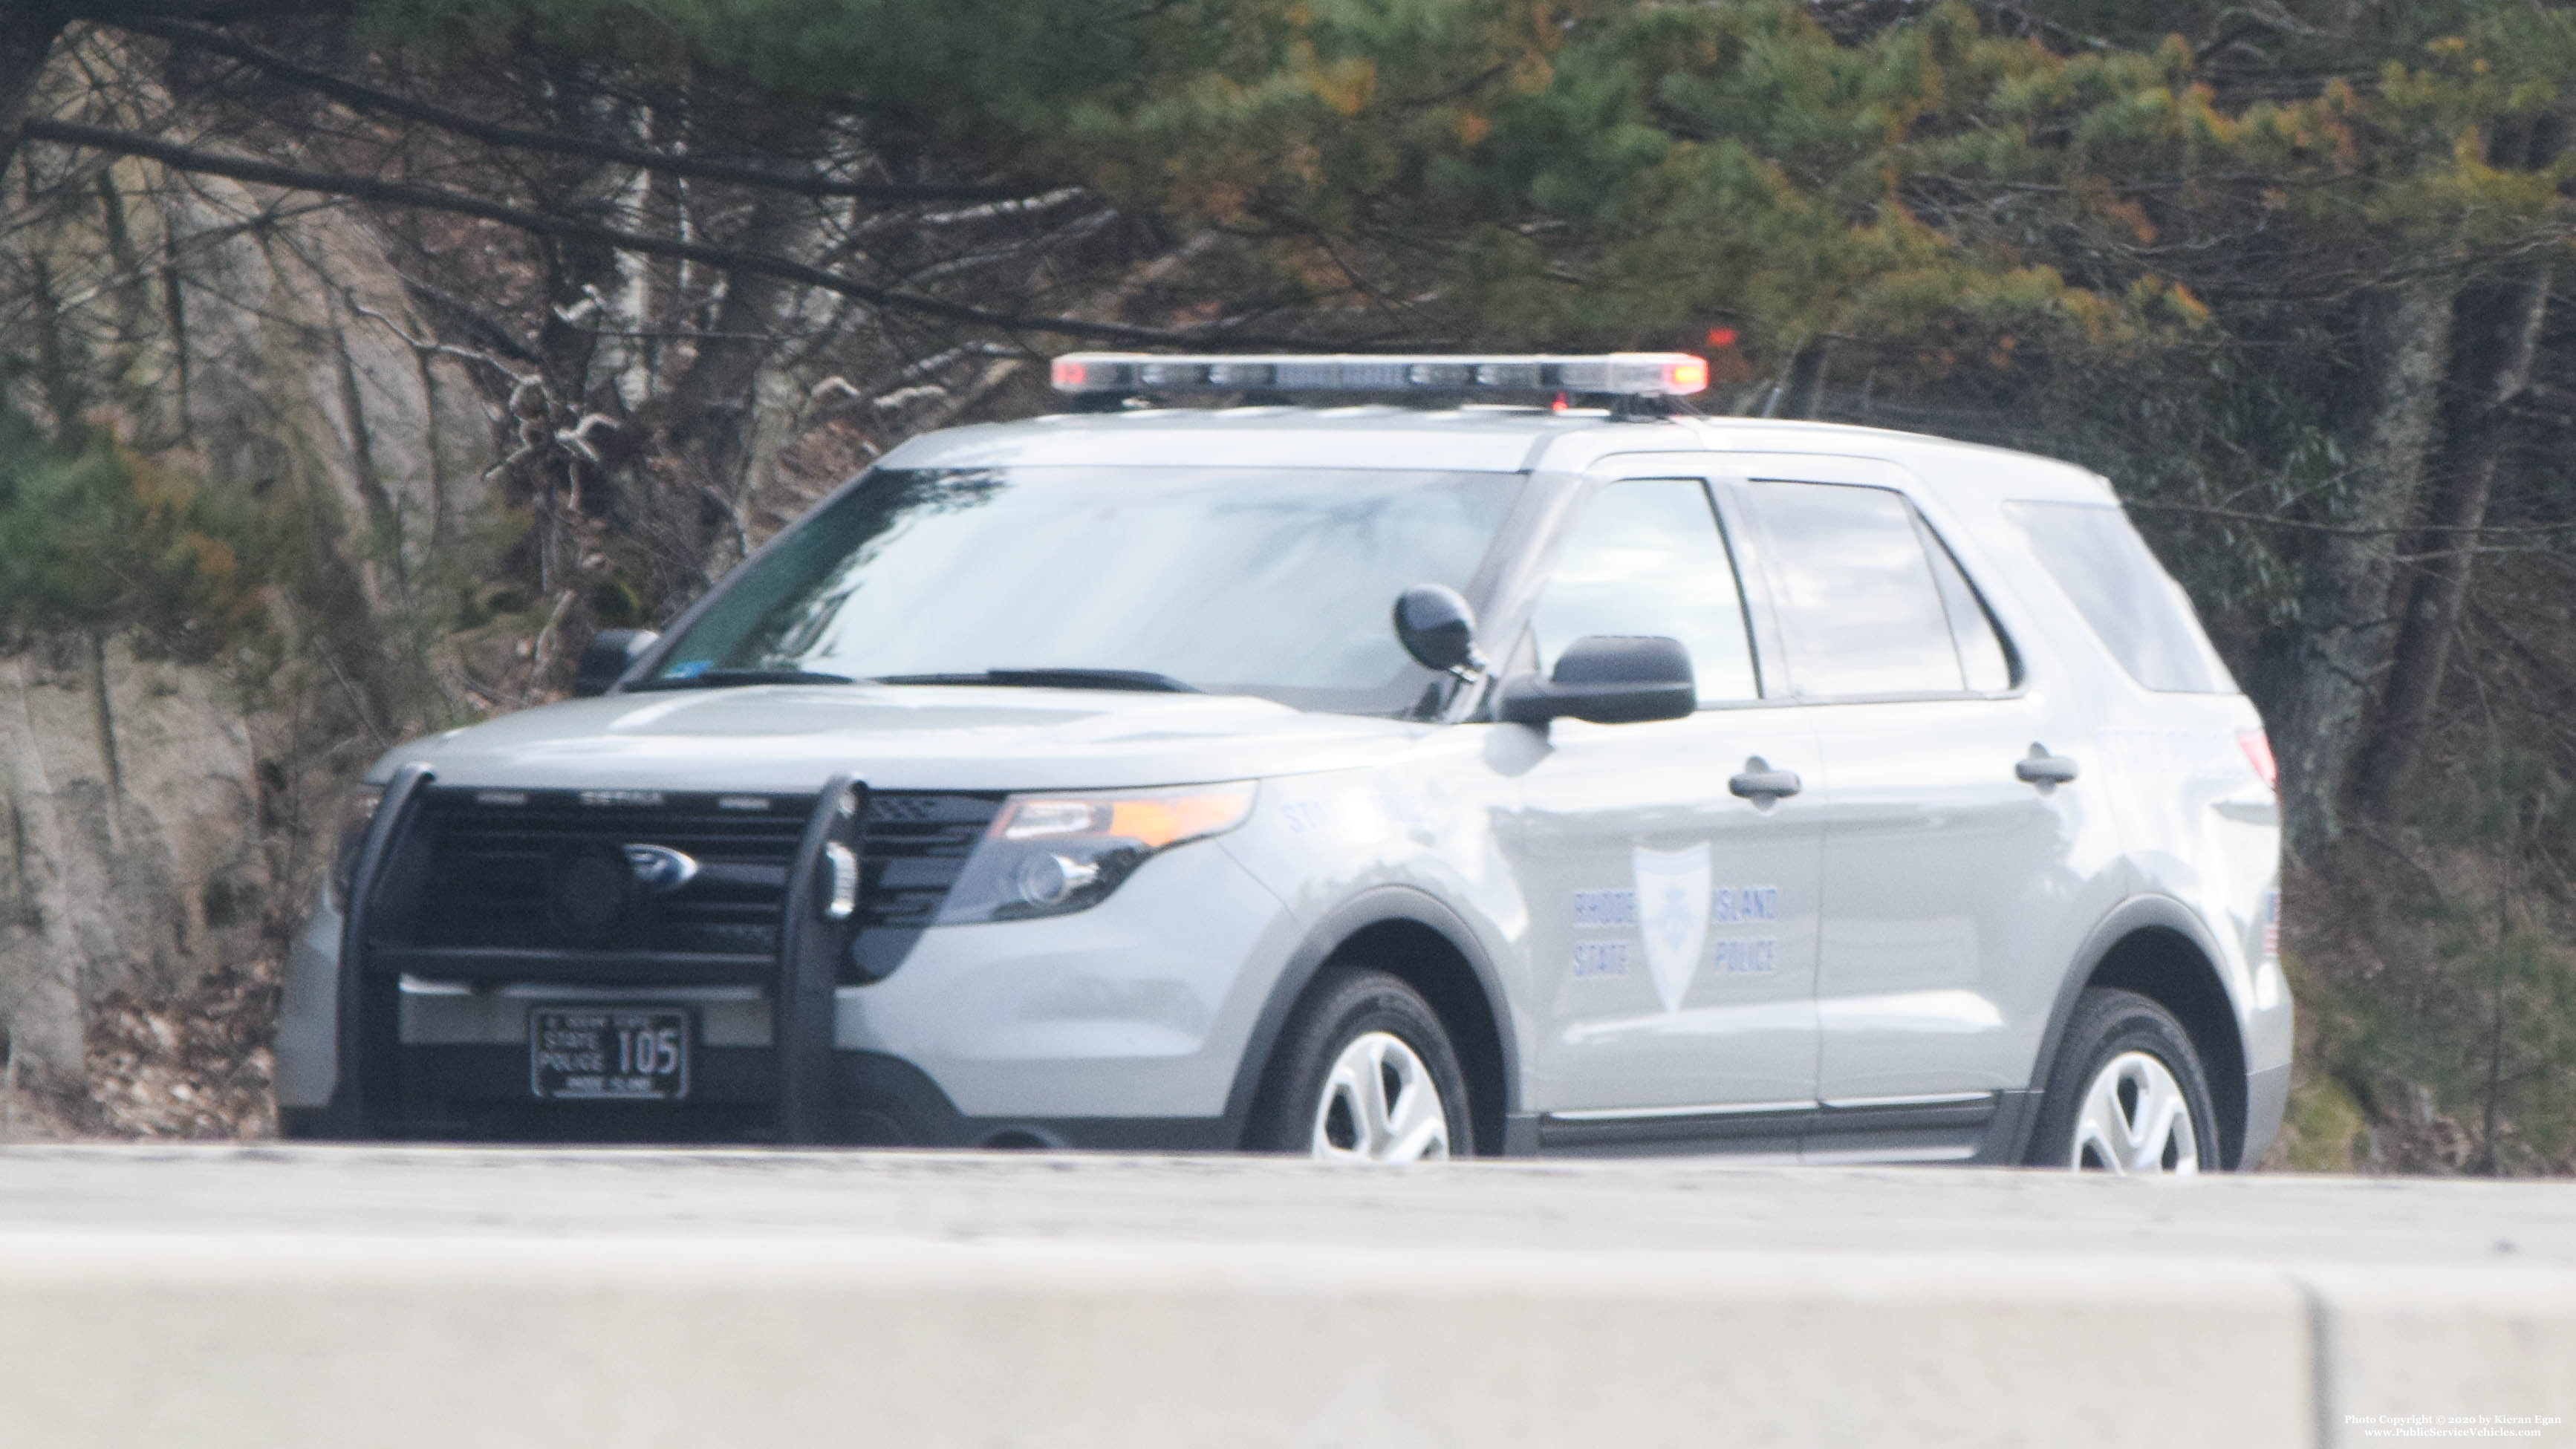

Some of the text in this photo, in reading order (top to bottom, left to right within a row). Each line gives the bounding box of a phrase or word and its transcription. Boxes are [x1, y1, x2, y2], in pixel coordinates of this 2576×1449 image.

[1573, 888, 1777, 923] RHODE ISLAND
[1574, 940, 1775, 977] STATE POLICE
[544, 1031, 596, 1049] STATE
[619, 1029, 677, 1074] 105
[540, 1052, 602, 1071] POLICE
